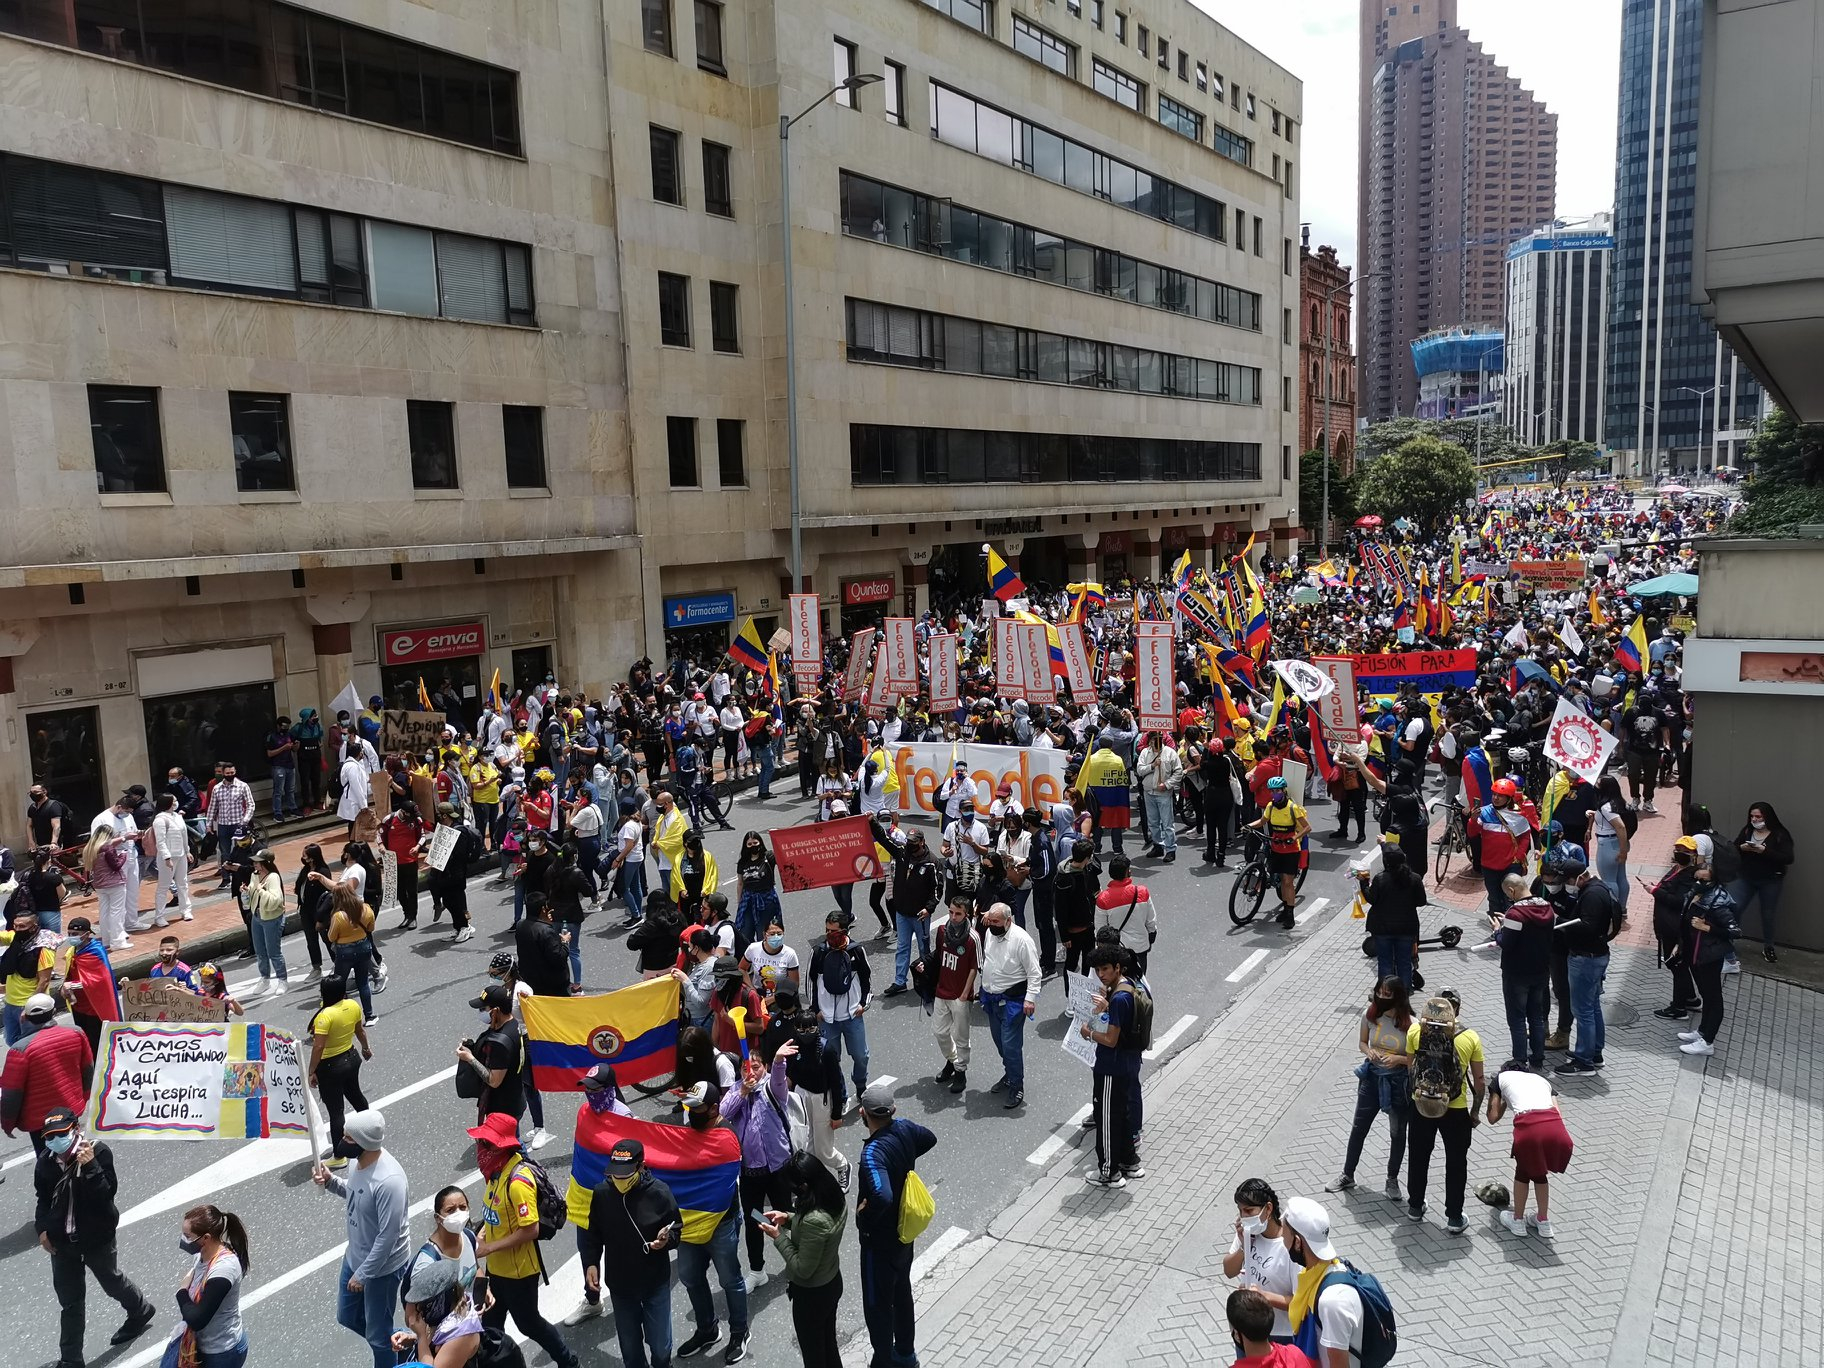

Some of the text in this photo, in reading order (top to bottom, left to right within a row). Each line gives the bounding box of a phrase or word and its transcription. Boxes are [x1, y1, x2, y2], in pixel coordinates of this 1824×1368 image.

[851, 581, 890, 602] Quintero
[1182, 592, 1221, 633] CUT
[800, 598, 811, 659] fecode
[895, 622, 907, 679] fecode
[1006, 622, 1015, 683] fecode
[1027, 628, 1042, 689] fecode
[1065, 627, 1084, 688] fecode
[939, 639, 948, 697] fecode
[1352, 653, 1456, 673] SFUSIÓN PARA
[105, 681, 127, 691] 28-07
[1150, 640, 1161, 712] fecode
[1145, 720, 1172, 728] fecode
[1564, 728, 1591, 754] CTC
[898, 746, 1063, 820] feode
[781, 842, 791, 850] EL
[791, 838, 818, 849] ORIGEN
[785, 839, 863, 858] ES LA EDUCACIÓN DEL
[812, 852, 841, 861] PUEBLO
[941, 950, 959, 971] FIAT
[117, 1036, 202, 1054] ¡VAMOS
[274, 1054, 299, 1066] CAMIN
[118, 1068, 161, 1090] Aquí
[116, 1084, 208, 1103] se respira
[134, 1103, 204, 1120] LUCHA...
